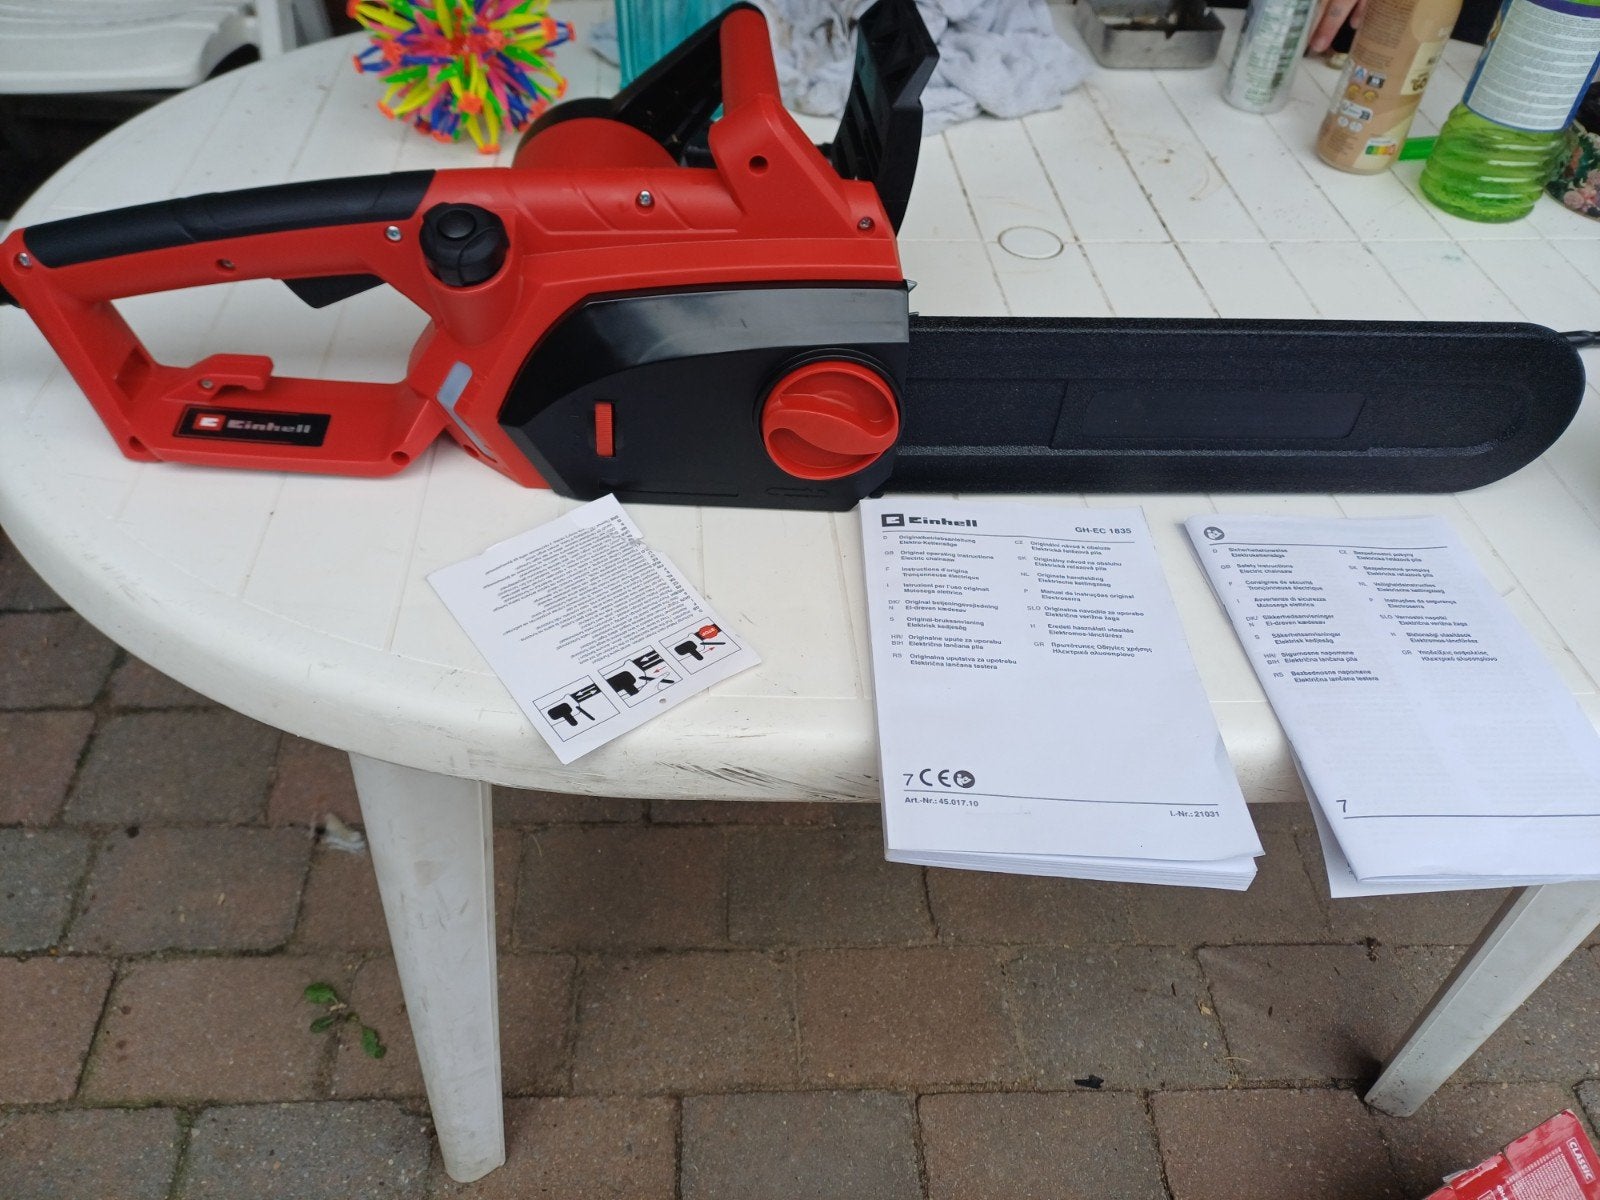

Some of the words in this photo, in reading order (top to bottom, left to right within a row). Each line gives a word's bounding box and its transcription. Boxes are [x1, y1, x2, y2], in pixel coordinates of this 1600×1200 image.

[226, 419, 312, 434] Einhell
[909, 516, 978, 527] Einhell
[903, 774, 913, 786] 7
[1336, 800, 1347, 813] 7
[1569, 1141, 1593, 1181] CLASSIC
